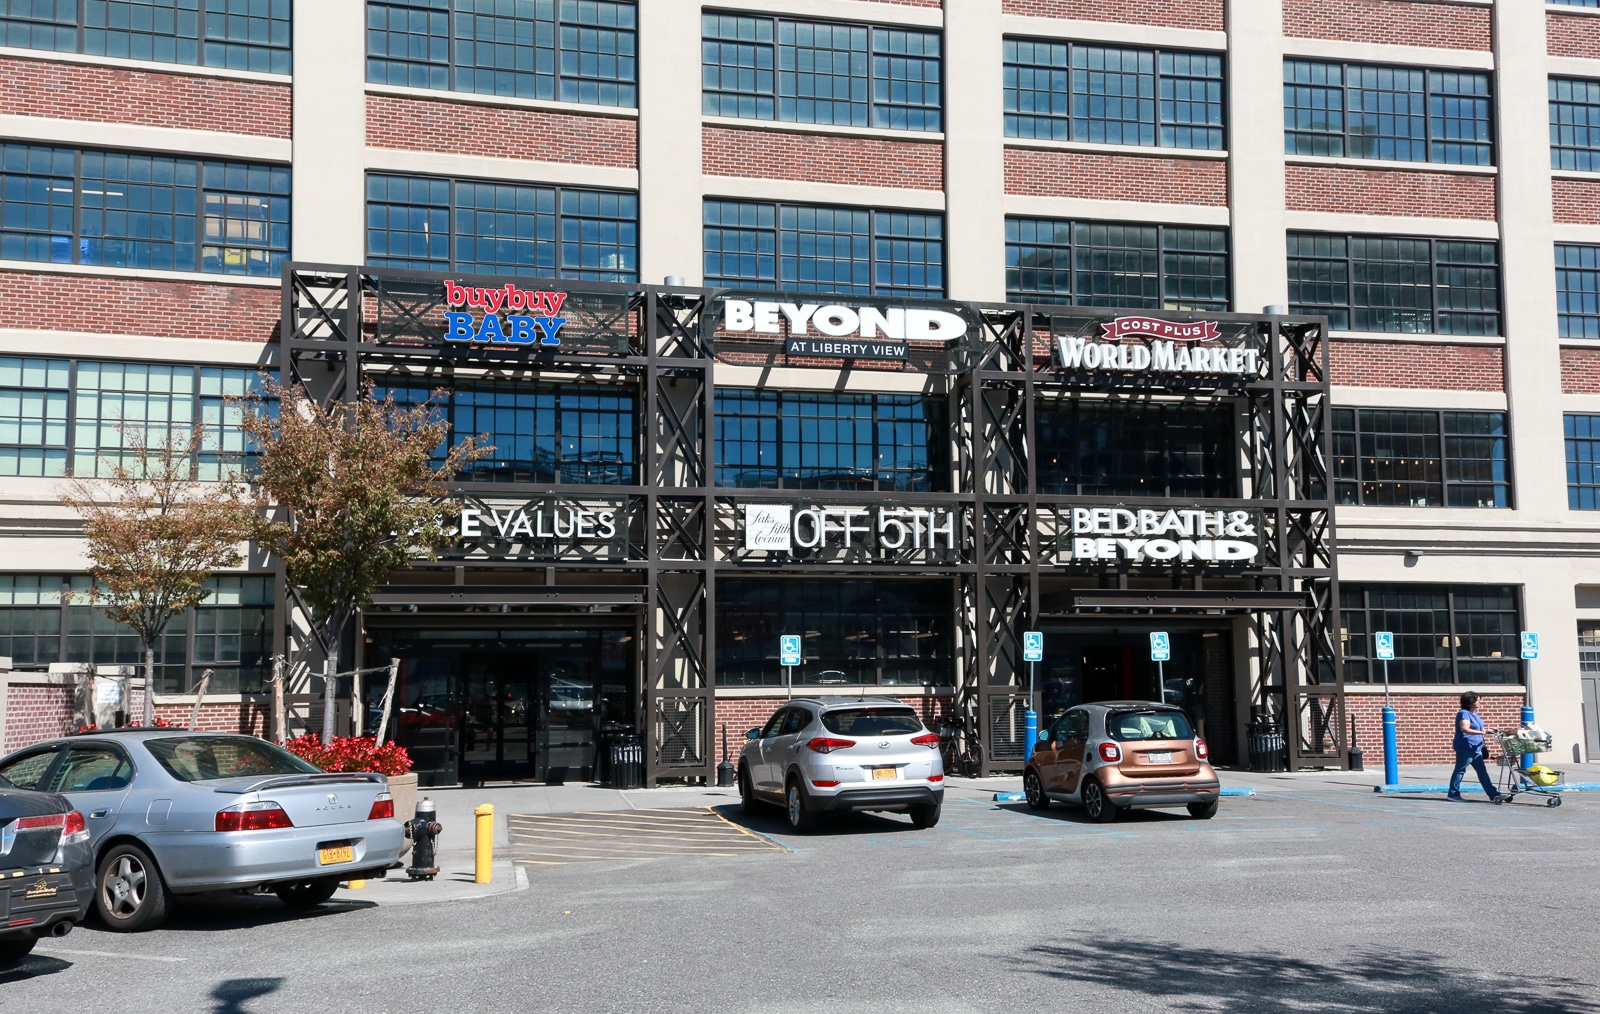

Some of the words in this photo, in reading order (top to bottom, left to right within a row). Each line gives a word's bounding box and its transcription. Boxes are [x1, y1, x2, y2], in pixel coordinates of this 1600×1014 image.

[444, 280, 567, 317] buybuy
[444, 312, 567, 345] BABY
[725, 299, 967, 341] BEYOND
[1121, 320, 1158, 332] COST
[1164, 326, 1201, 337] PLUS
[791, 342, 807, 352] AT
[812, 343, 868, 355] LIBERTY
[873, 346, 905, 356] VIEW
[490, 510, 616, 539] VALUES
[794, 509, 870, 548] OFF
[878, 511, 954, 549] 5TH
[1071, 507, 1136, 533] BED
[1137, 508, 1224, 536] BATH
[1225, 510, 1258, 537] &
[1072, 538, 1258, 561] BEYOND
